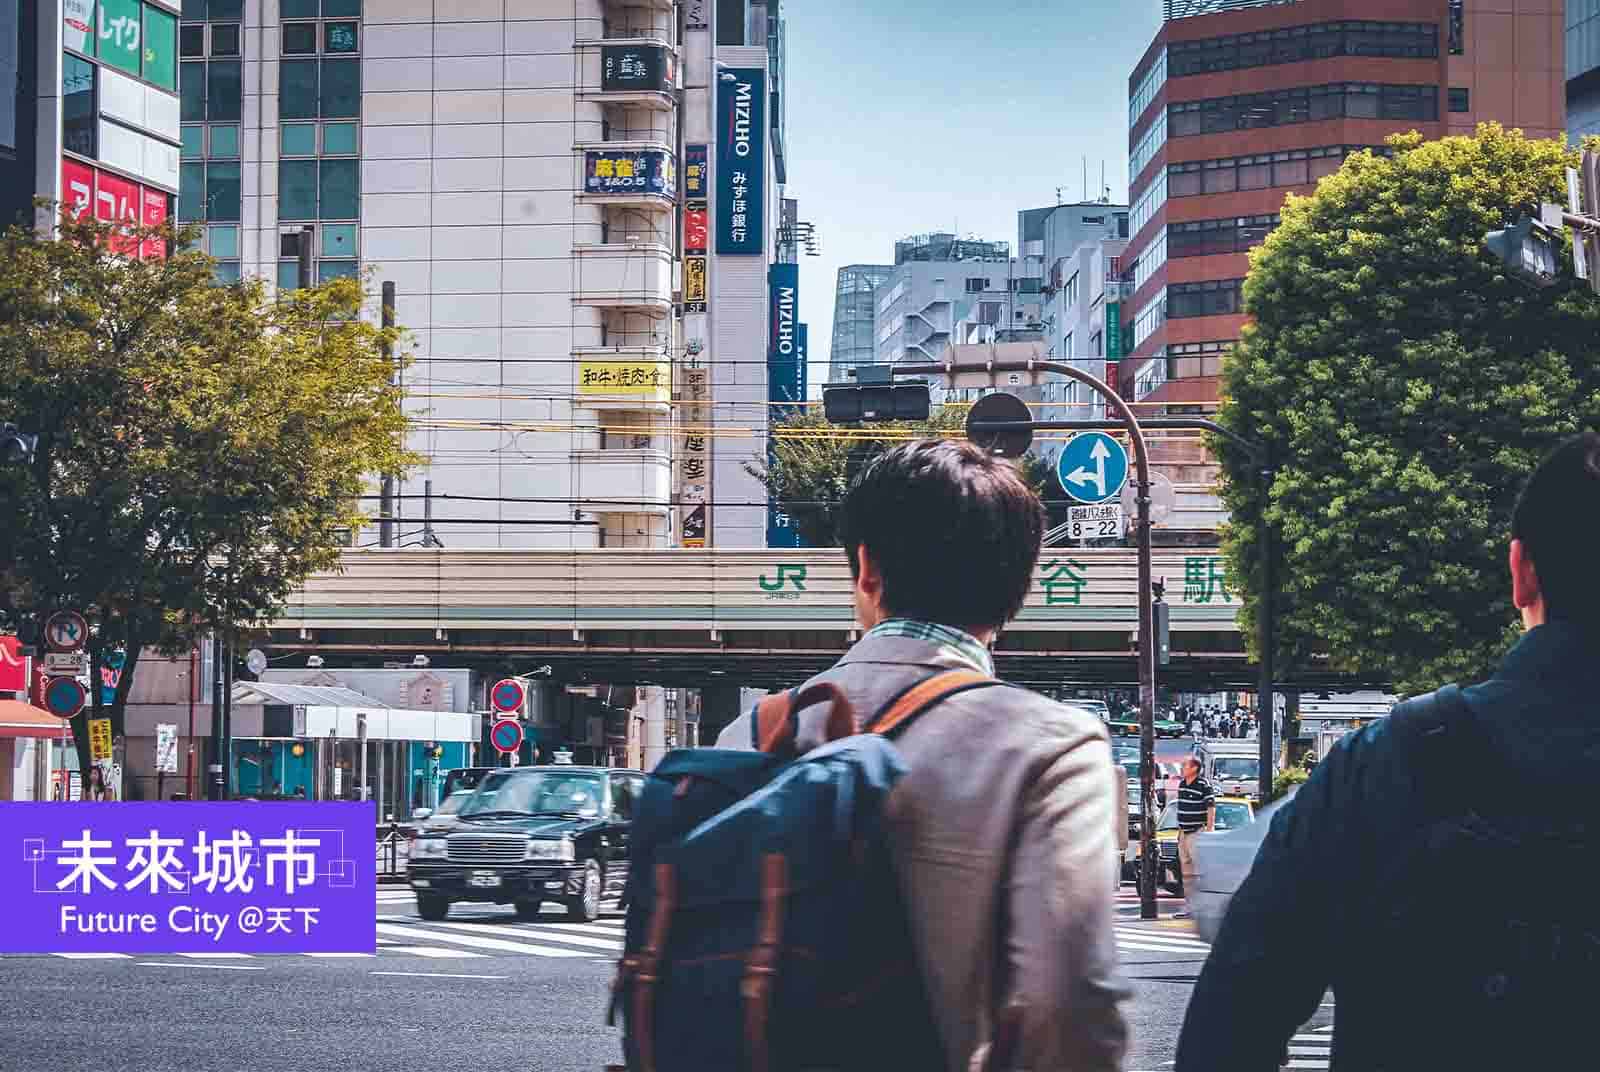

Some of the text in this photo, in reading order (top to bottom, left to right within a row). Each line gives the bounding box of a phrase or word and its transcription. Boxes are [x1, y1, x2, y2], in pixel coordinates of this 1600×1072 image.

[98, 4, 140, 51] レイク
[735, 82, 752, 156] MIZUHO
[731, 171, 747, 242] みずほ銀行
[779, 287, 794, 354] MIZUHO
[759, 563, 807, 591] JR
